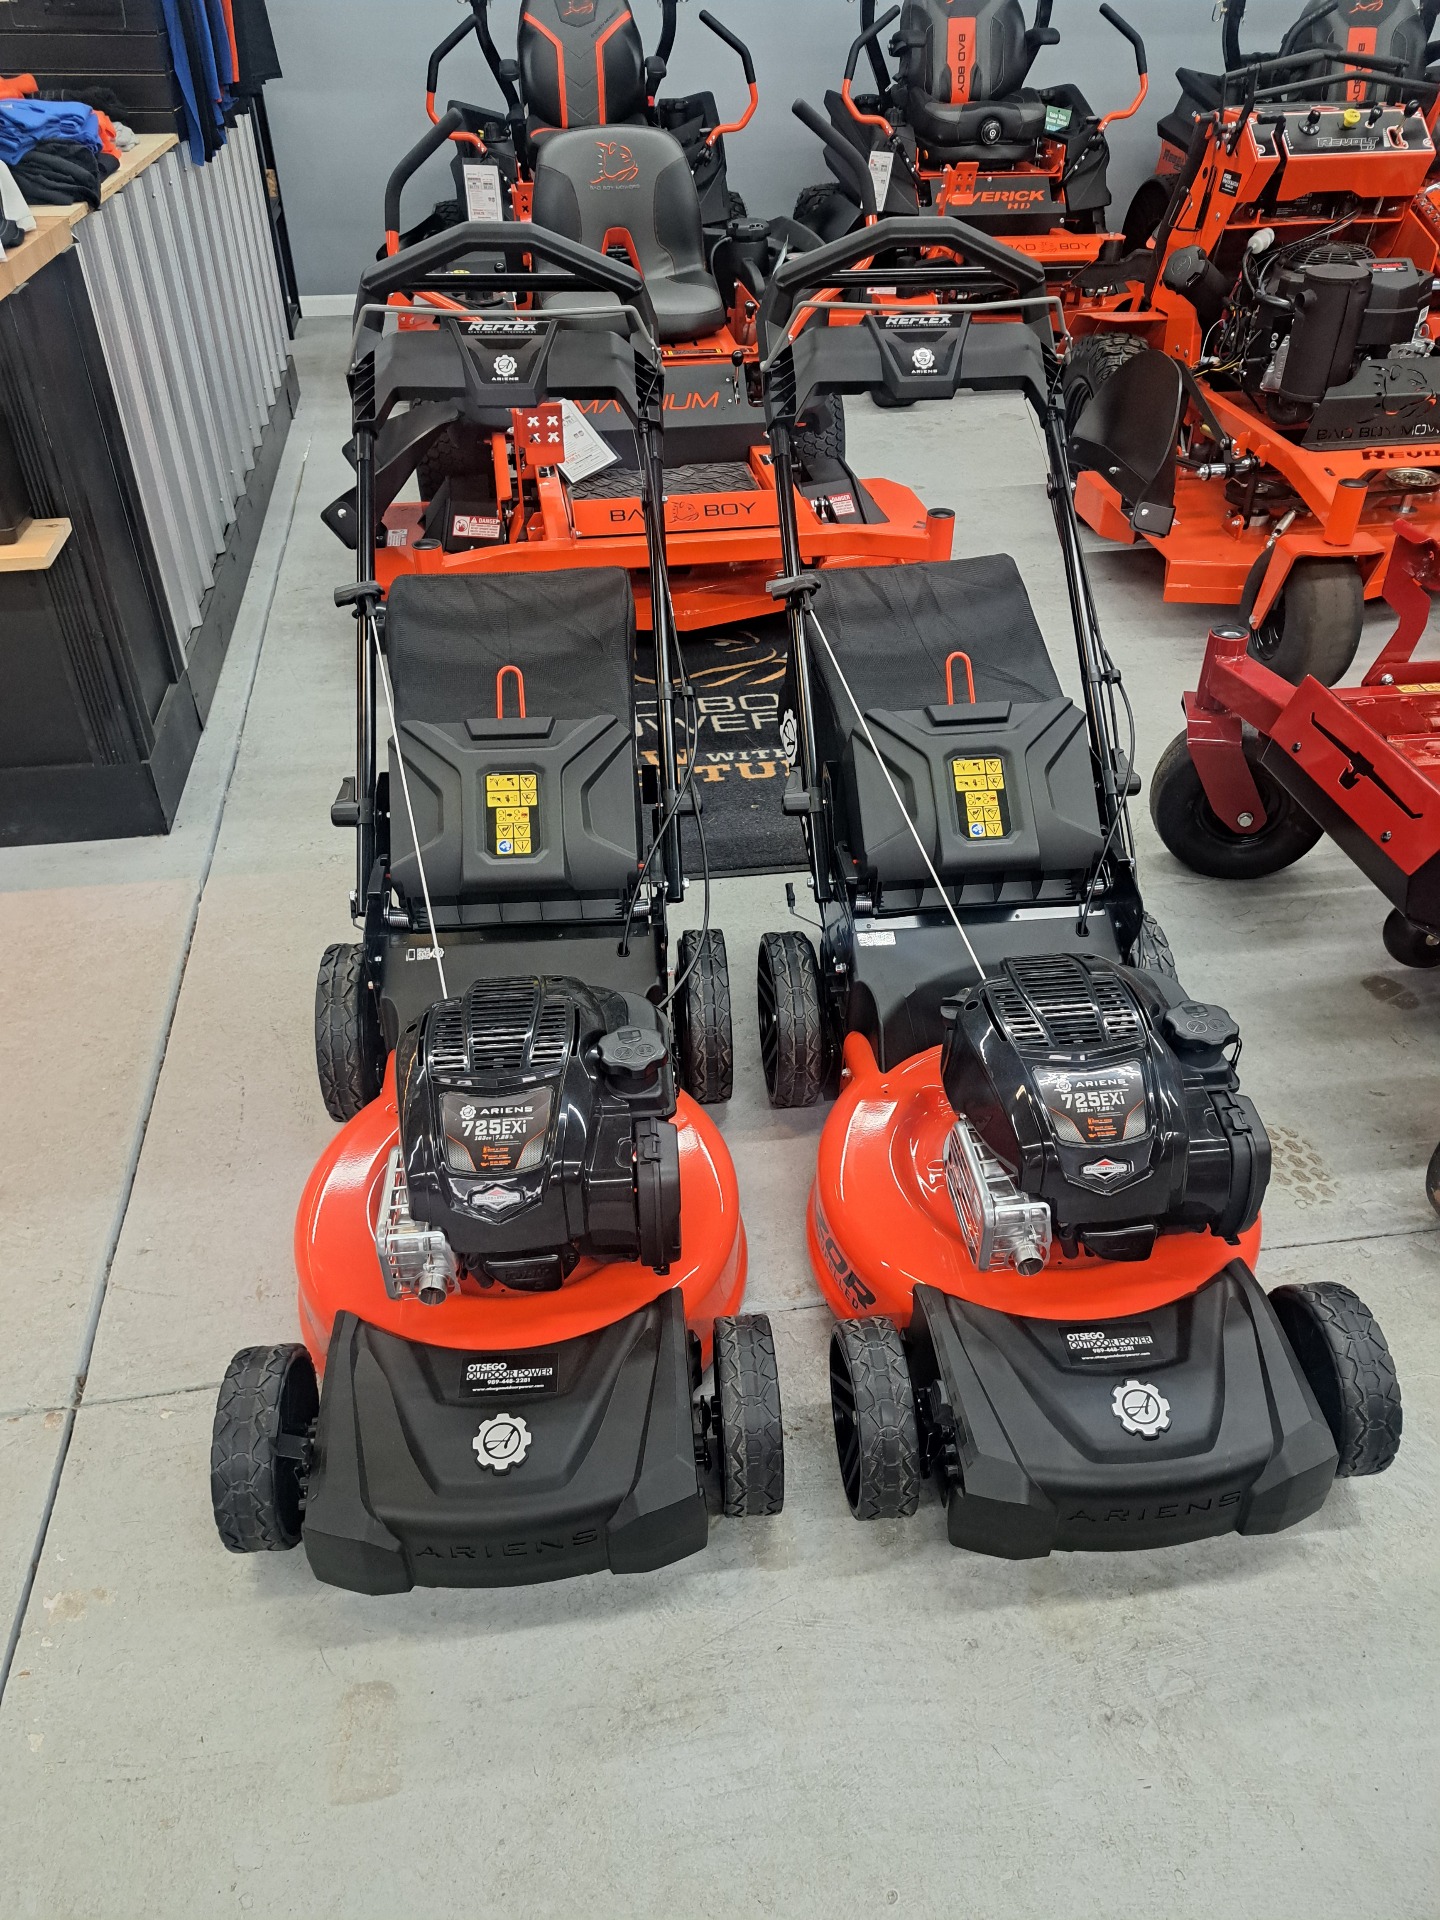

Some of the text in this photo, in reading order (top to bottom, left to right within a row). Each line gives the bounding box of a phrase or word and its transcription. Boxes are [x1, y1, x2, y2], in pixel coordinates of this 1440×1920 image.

[957, 33, 966, 94] BAD BOY
[467, 322, 537, 331] REFLEX
[885, 314, 952, 325] REFLEX
[704, 502, 756, 516] BOY
[1076, 1079, 1126, 1088] ARIENS
[1060, 1091, 1125, 1109] 725EXi
[480, 1106, 533, 1115] ARIENS
[461, 1119, 527, 1137] 725EXi
[1066, 1331, 1105, 1341] OTSEGO
[1068, 1335, 1154, 1350] OUTDOOR POWER
[466, 1367, 553, 1381] OUTDOOR POWER
[467, 1362, 507, 1372] OTSEGO
[1066, 1490, 1242, 1523] ARIENS
[415, 1528, 598, 1560] ARIENS
